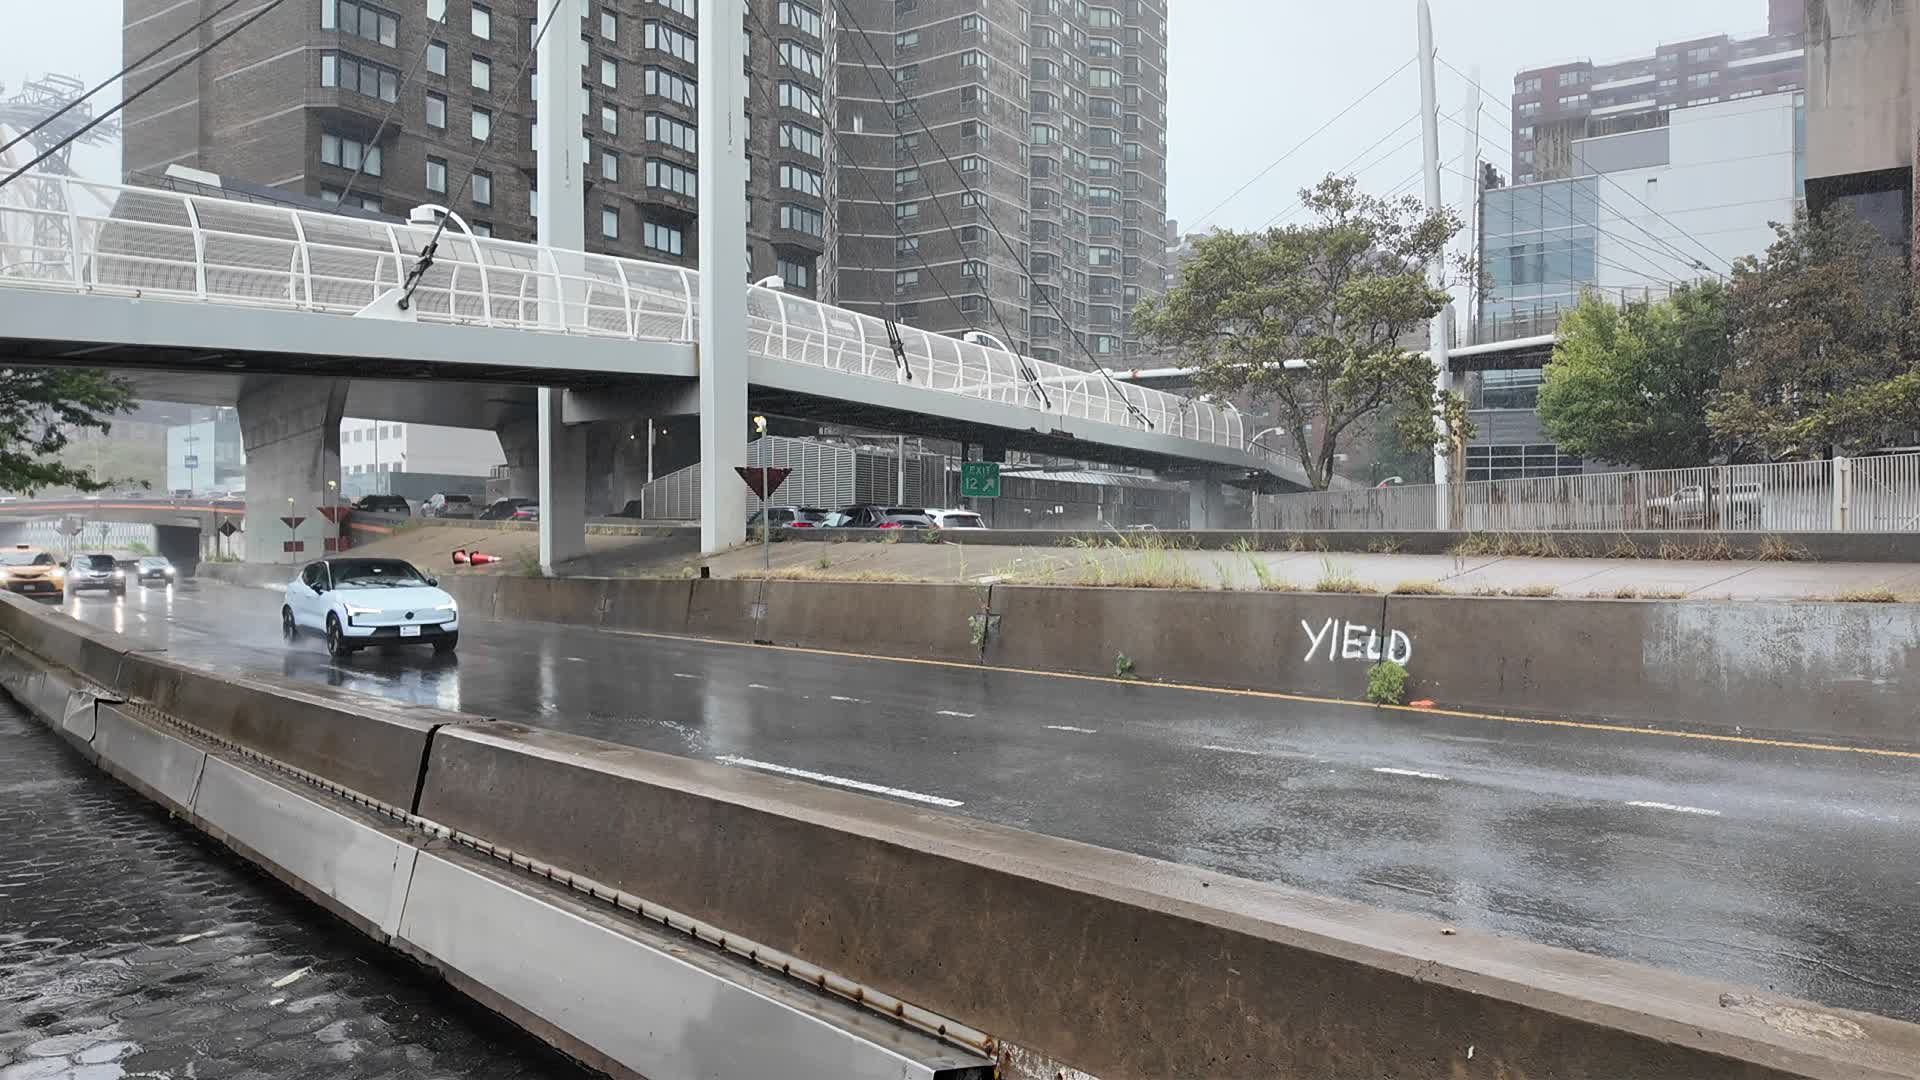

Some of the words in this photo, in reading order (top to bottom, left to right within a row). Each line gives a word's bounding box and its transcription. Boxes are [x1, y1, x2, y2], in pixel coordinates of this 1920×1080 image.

[970, 465, 992, 475] EXIT
[966, 477, 978, 490] 12
[1301, 616, 1412, 666] YIELD
